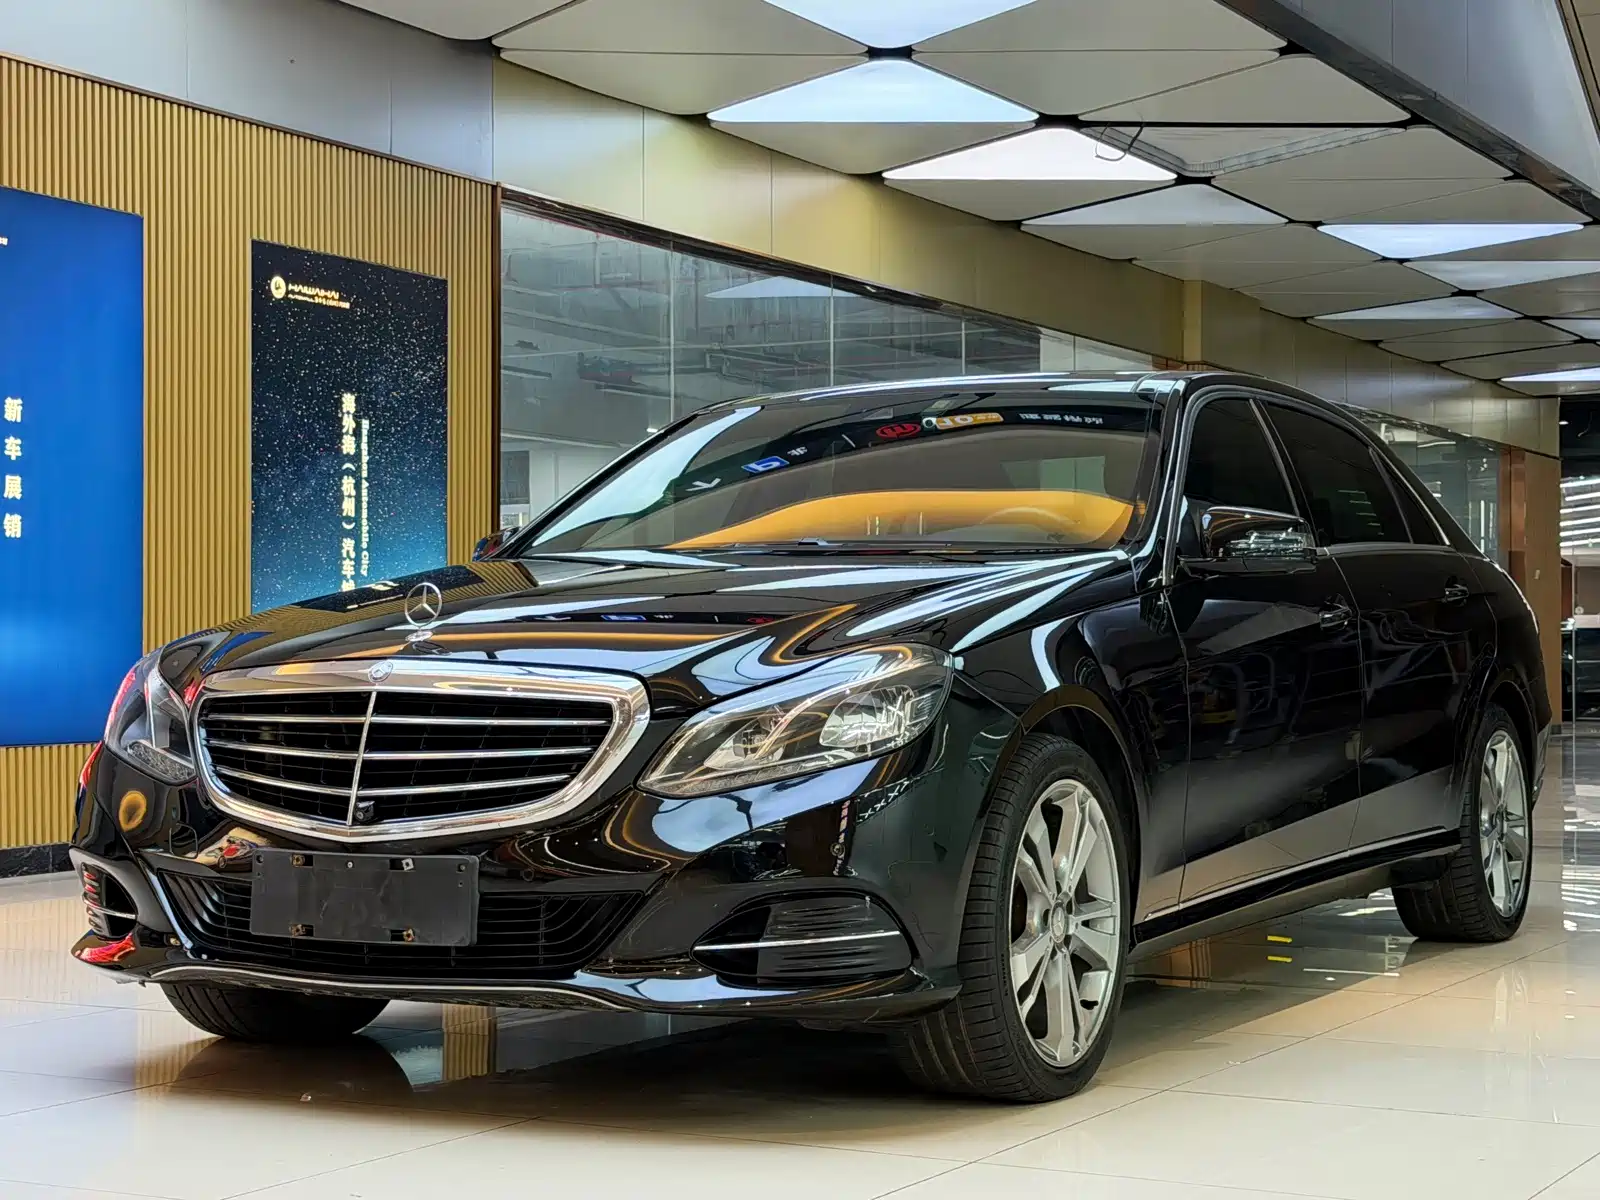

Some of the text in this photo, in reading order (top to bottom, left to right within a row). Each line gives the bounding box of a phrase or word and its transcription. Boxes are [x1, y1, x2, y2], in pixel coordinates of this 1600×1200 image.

[3, 396, 23, 538] 新车展销
[361, 479, 370, 549] Automobile
[360, 550, 370, 577] City
